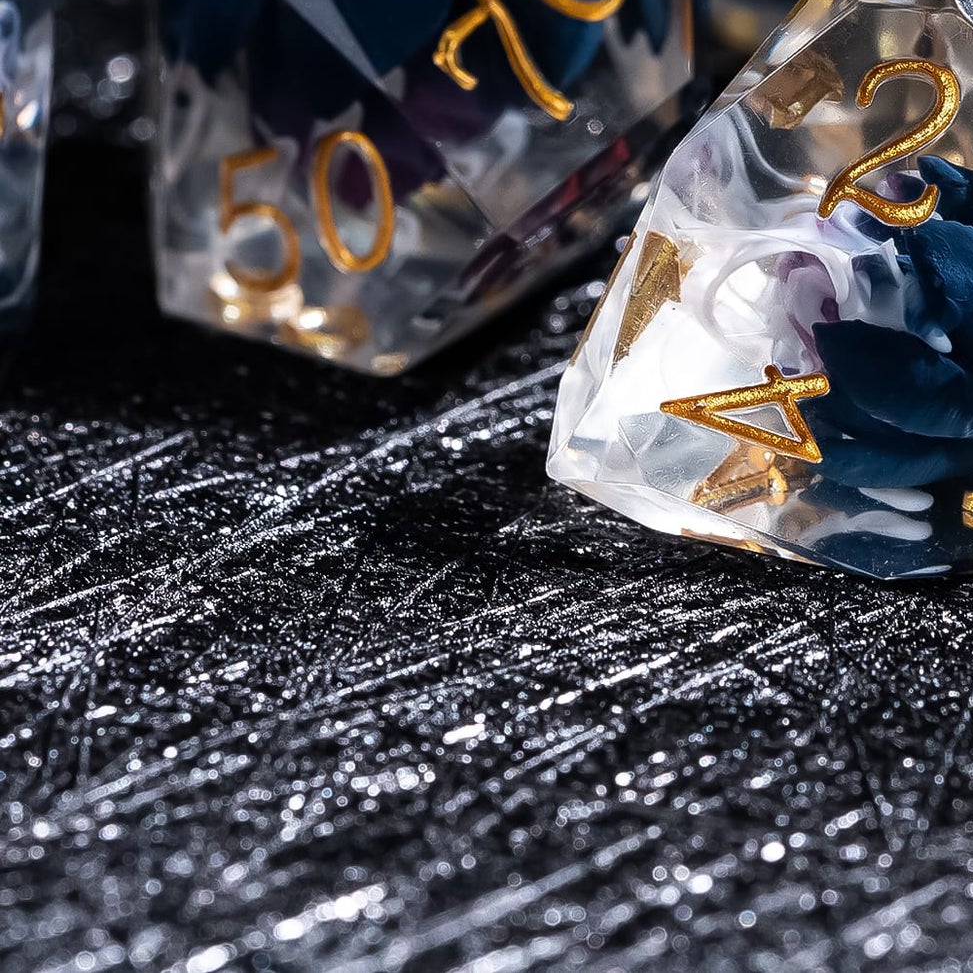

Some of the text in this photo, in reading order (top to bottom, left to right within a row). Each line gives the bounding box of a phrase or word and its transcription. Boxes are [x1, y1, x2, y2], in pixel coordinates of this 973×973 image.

[216, 129, 395, 293] 50
[817, 57, 962, 228] 2
[658, 364, 832, 464] 4
